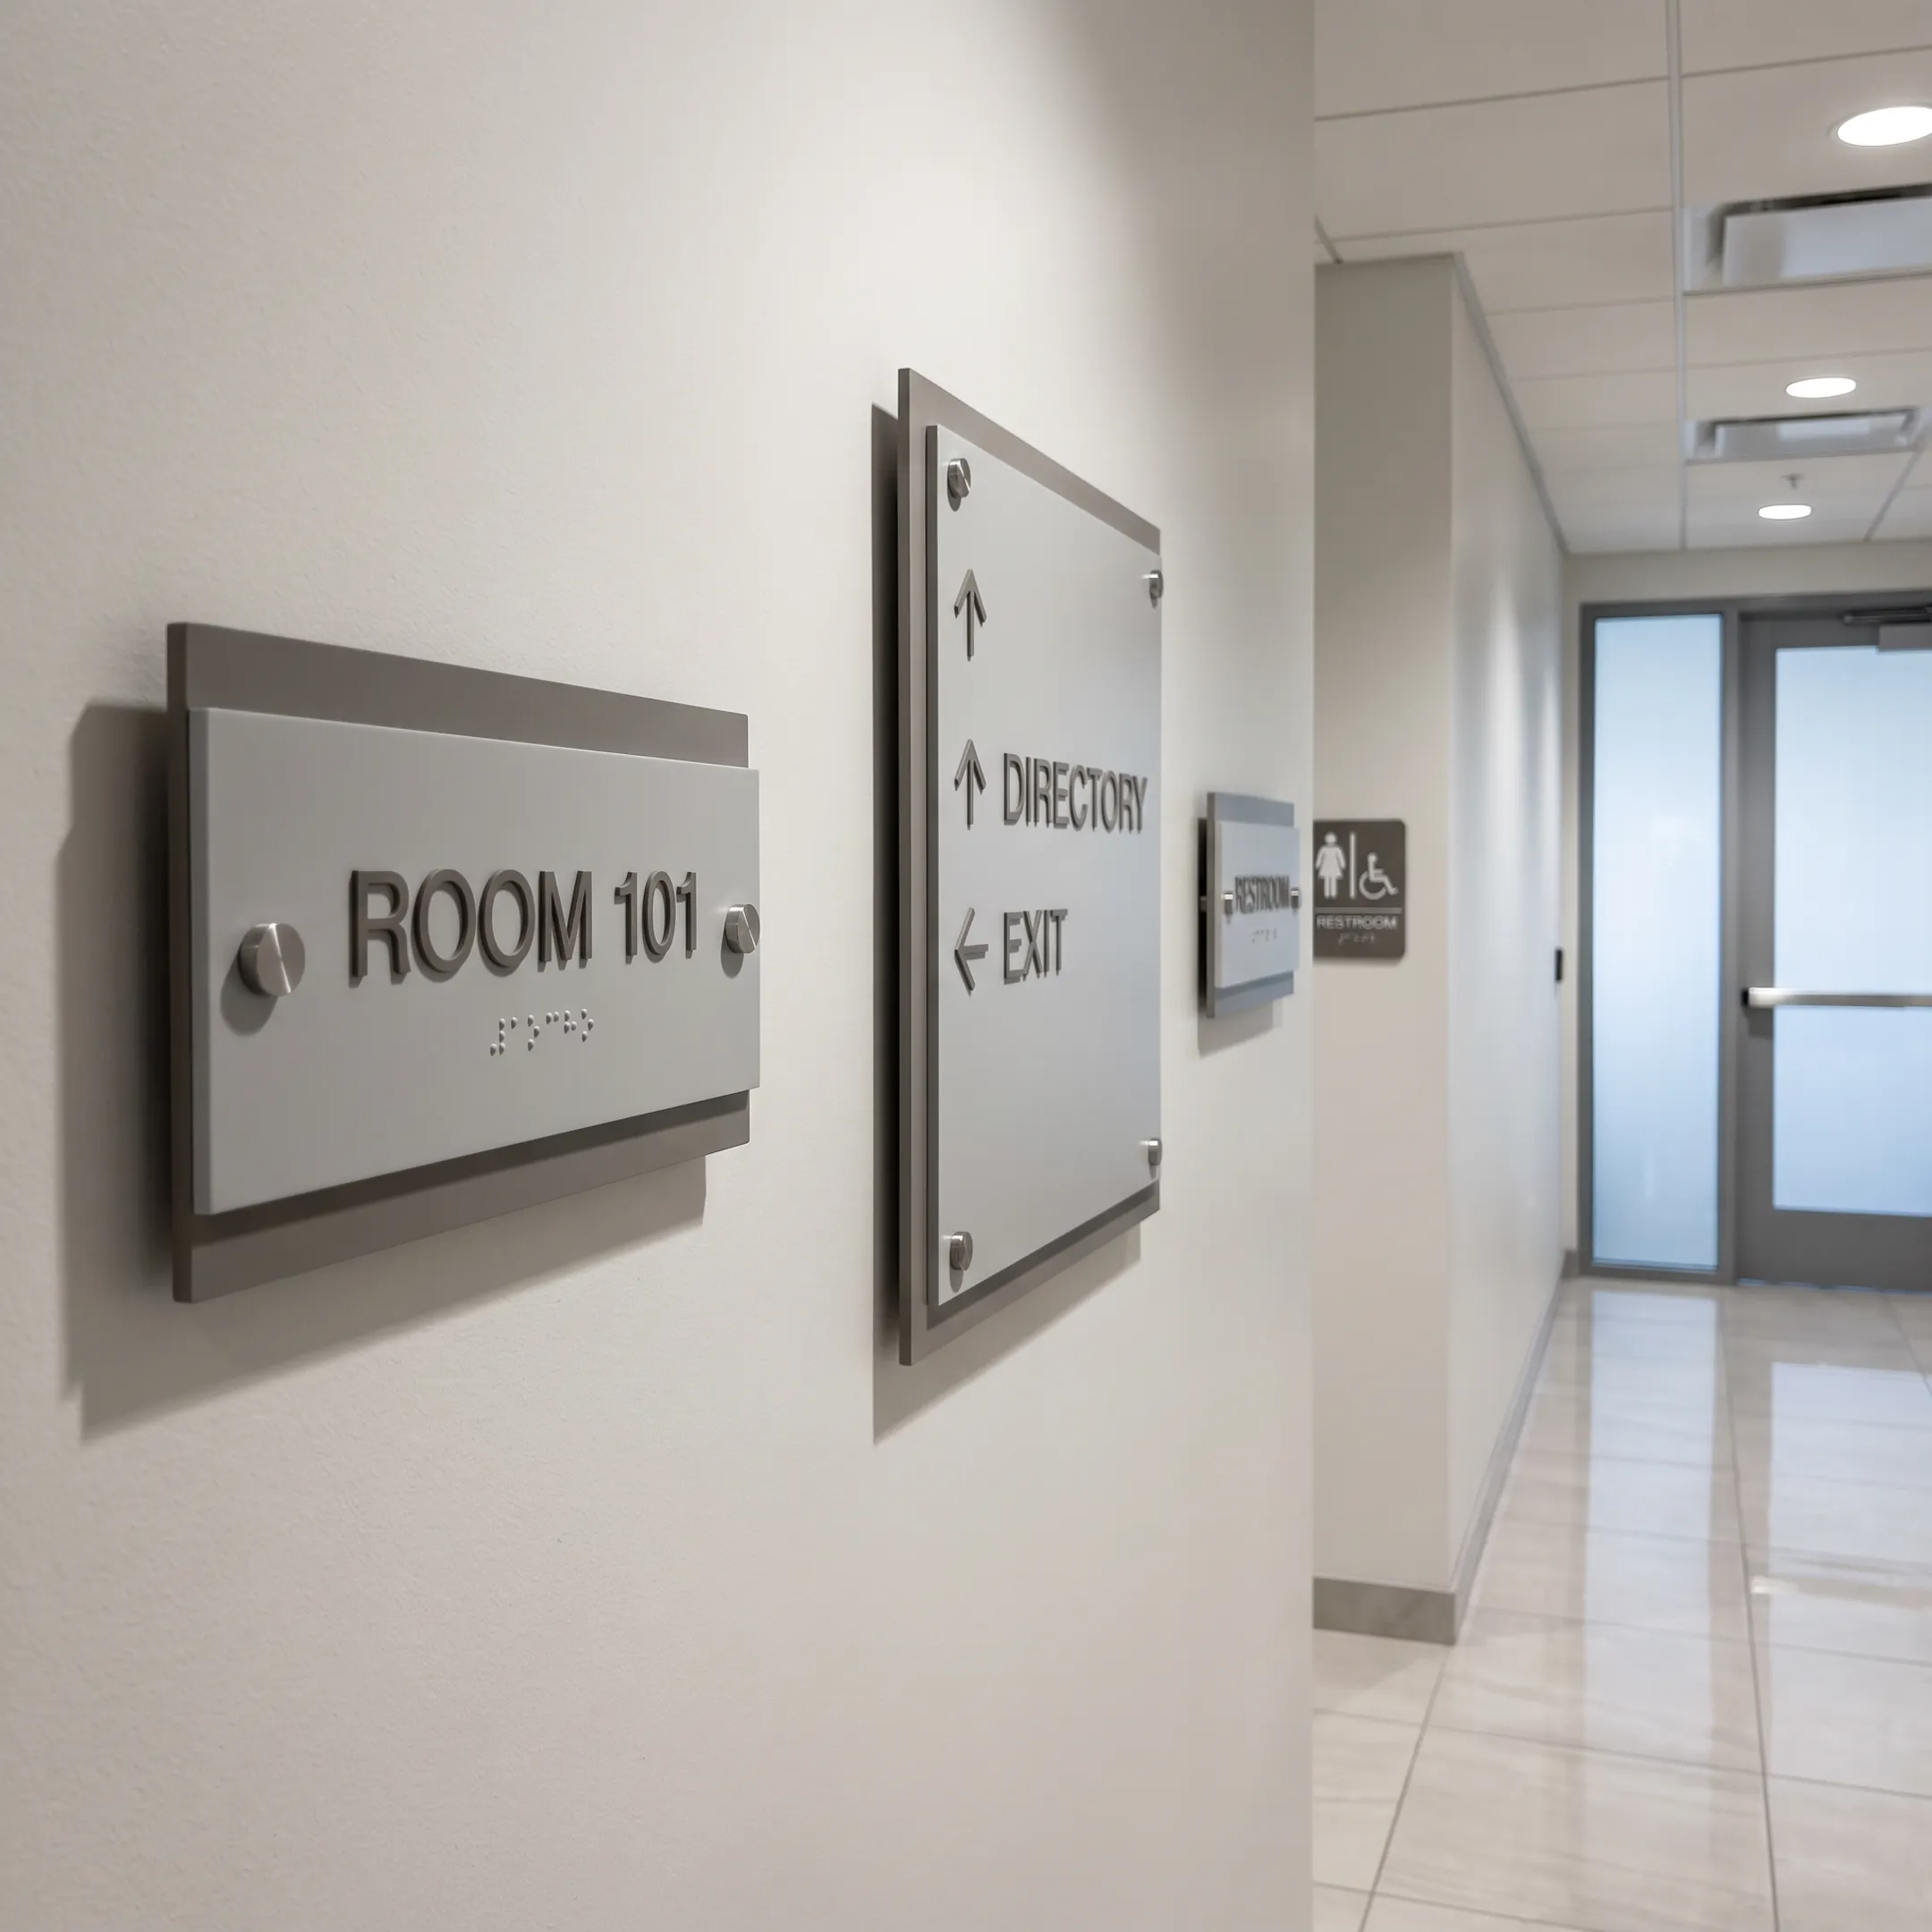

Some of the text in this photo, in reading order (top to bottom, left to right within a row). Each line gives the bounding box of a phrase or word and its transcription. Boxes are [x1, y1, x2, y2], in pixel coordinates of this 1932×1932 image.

[1003, 752, 1148, 834] DIRECTORY
[349, 869, 697, 979] ROOM 101
[1004, 909, 1068, 983] EXIT
[1316, 915, 1397, 929] RESTROOM
